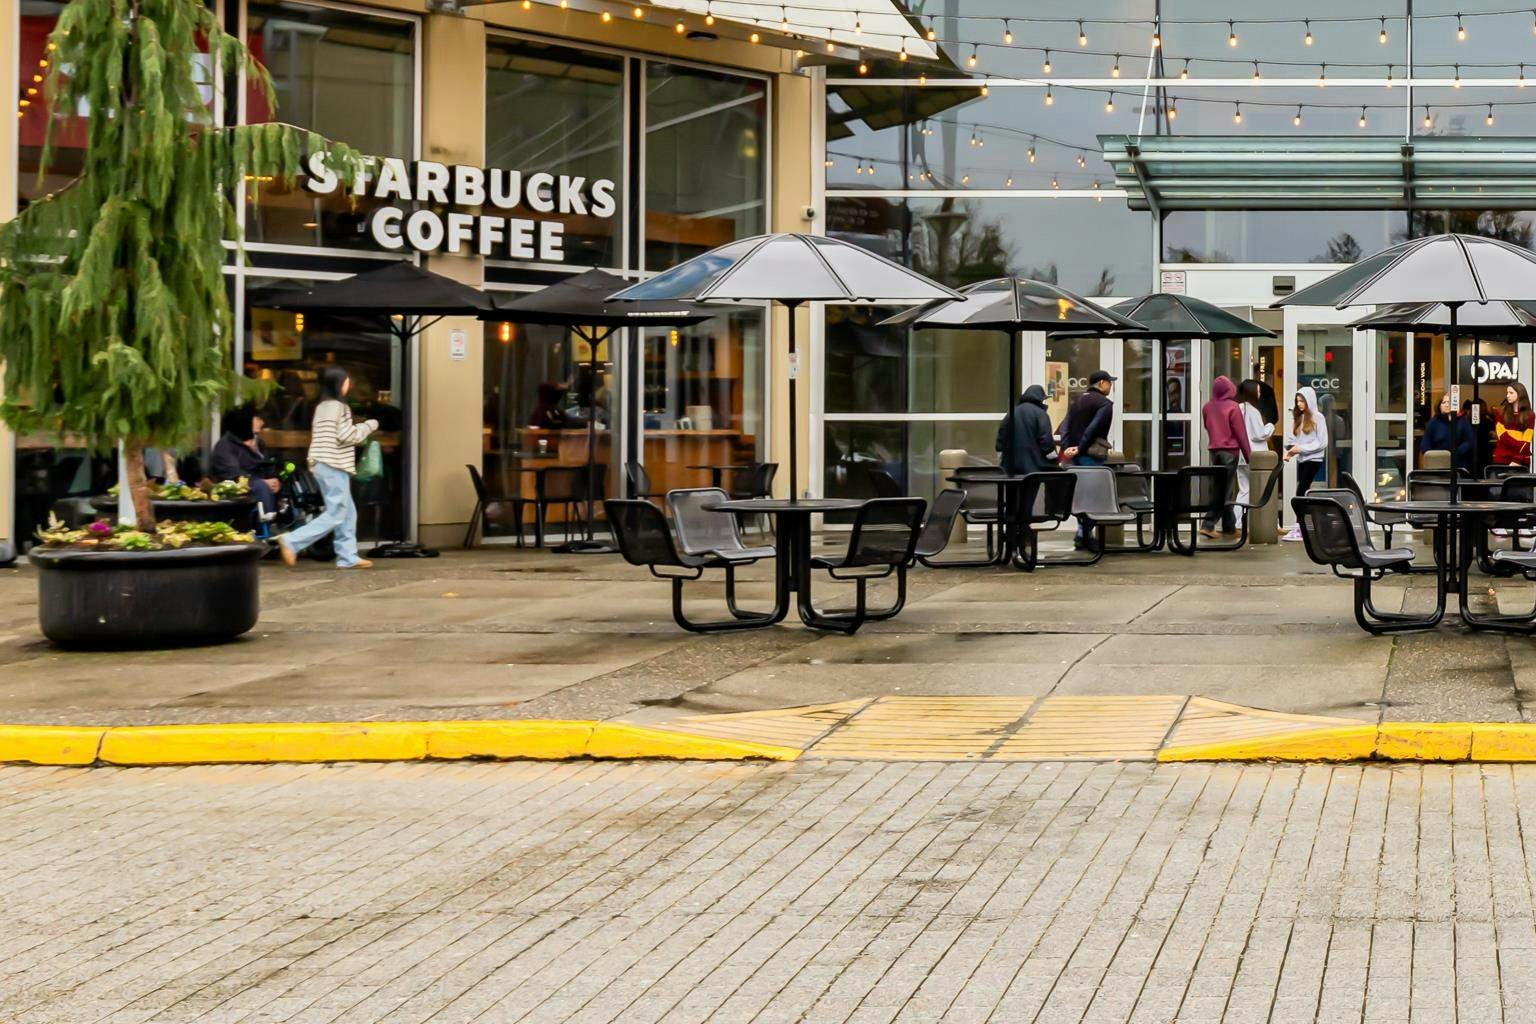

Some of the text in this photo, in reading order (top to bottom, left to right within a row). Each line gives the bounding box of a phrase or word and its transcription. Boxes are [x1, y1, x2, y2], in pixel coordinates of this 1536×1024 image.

[306, 150, 617, 218] STARBUCKS
[371, 206, 565, 262] COFFEE
[1311, 378, 1340, 390] CQC
[1471, 357, 1518, 384] OPA!
